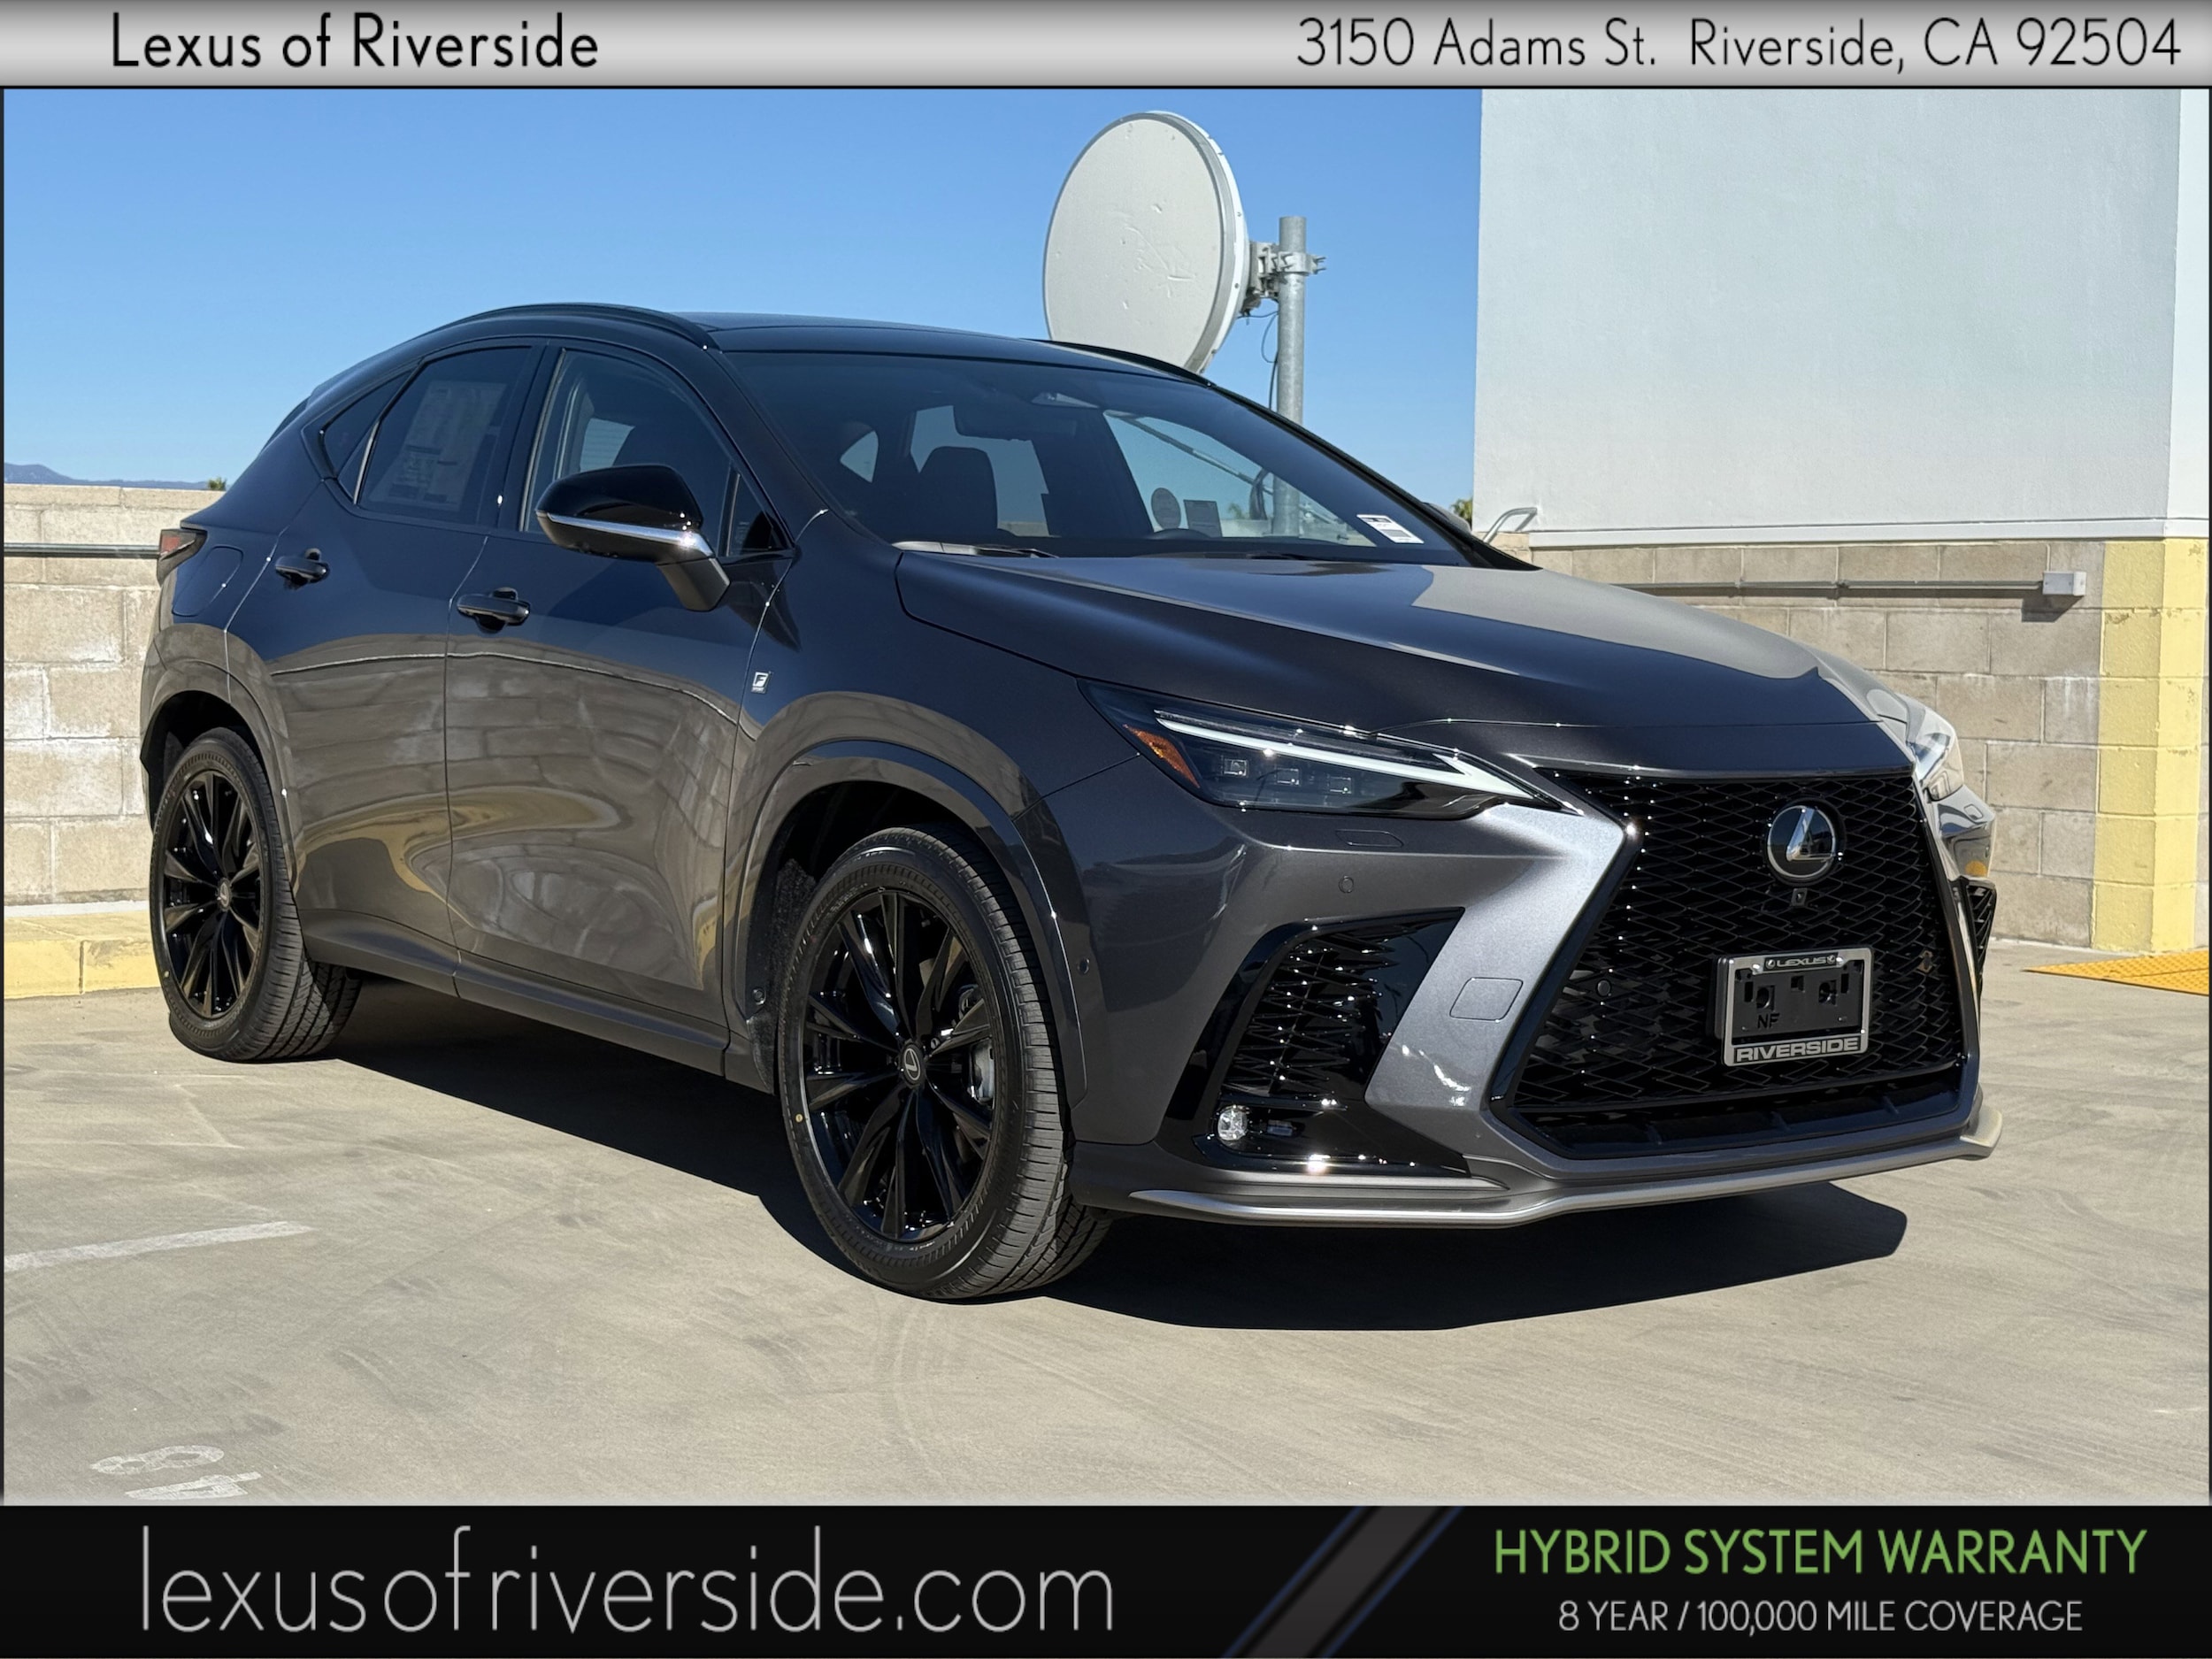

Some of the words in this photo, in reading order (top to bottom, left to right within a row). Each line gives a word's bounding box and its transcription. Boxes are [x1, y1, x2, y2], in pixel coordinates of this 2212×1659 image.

[1776, 956, 1827, 968] LEXUS
[1757, 1013, 1780, 1029] NF
[1736, 1037, 1859, 1063] RIVERSIDE
